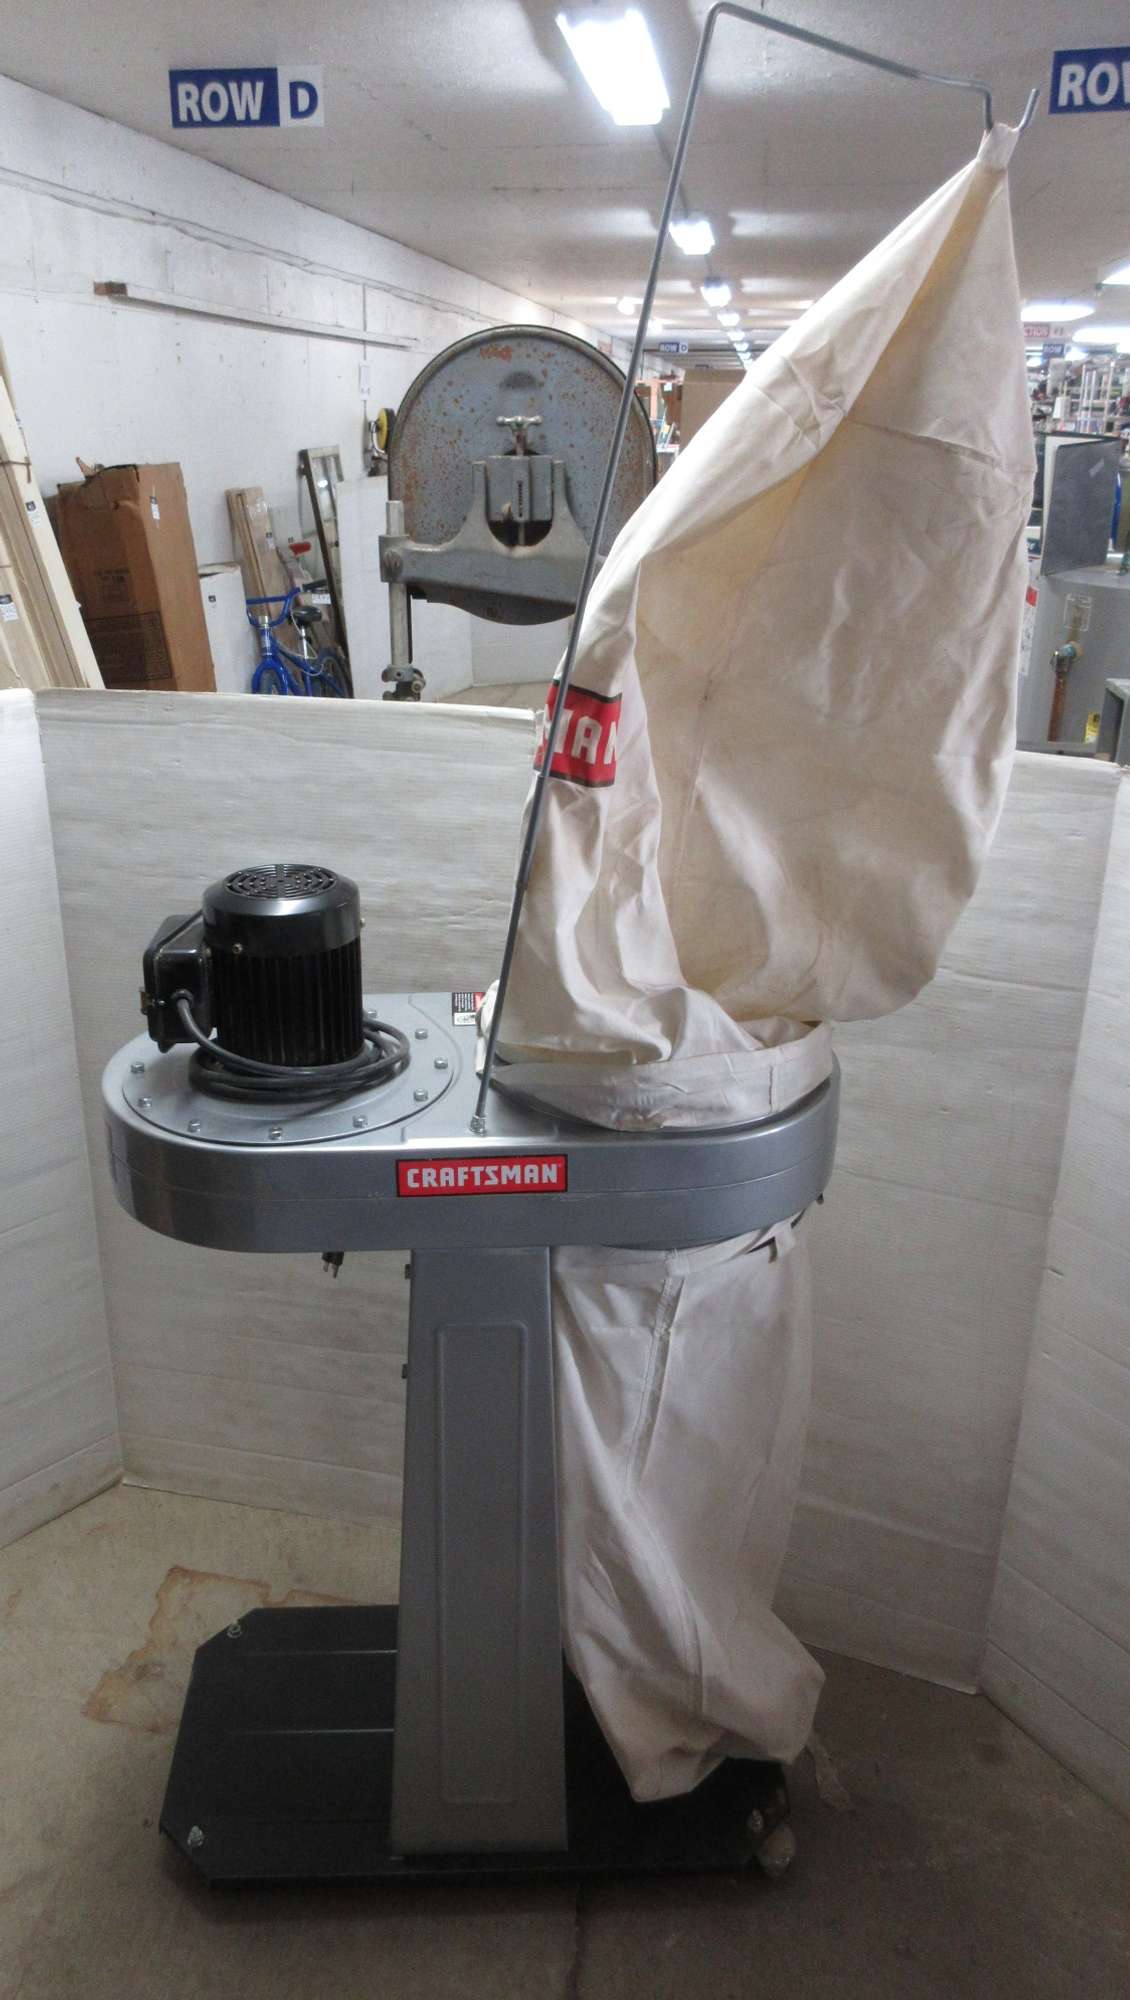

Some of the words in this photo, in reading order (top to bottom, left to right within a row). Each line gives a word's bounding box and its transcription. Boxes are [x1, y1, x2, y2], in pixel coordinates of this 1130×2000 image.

[177, 80, 265, 122] ROW
[288, 80, 319, 120] D
[659, 343, 678, 353] ROW
[406, 1163, 558, 1189] CRAFTSMAN
